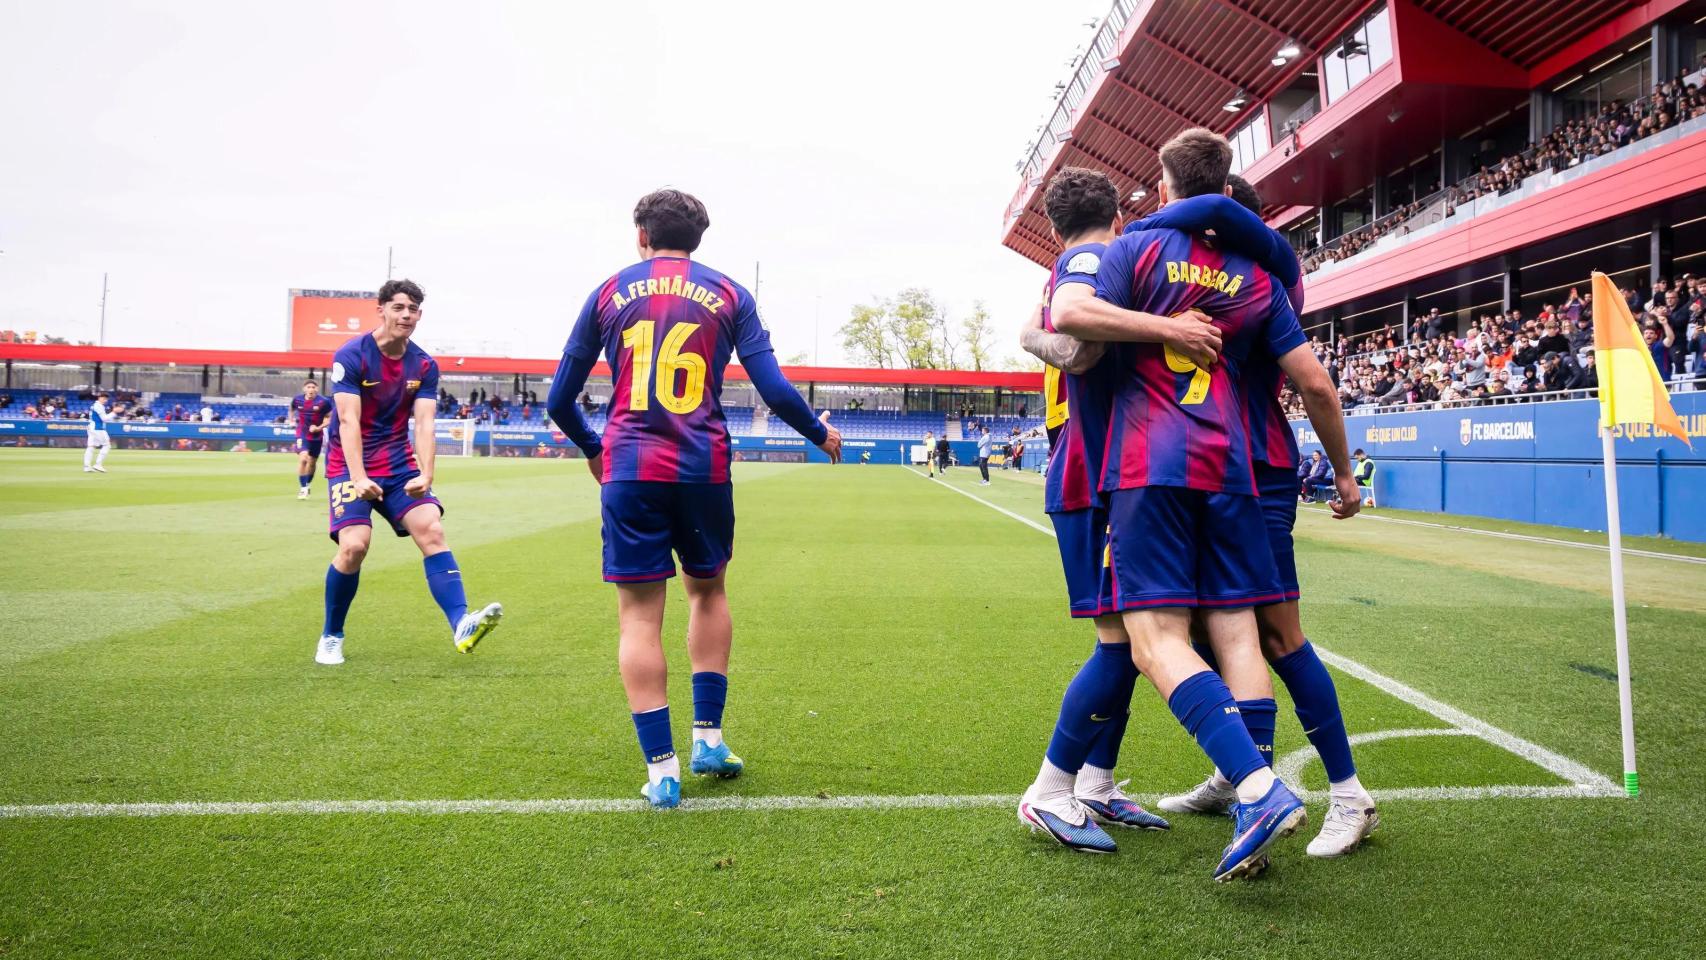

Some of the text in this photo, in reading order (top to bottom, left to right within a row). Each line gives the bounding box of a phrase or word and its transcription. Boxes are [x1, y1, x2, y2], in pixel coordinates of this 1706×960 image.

[302, 289, 330, 298] ESTADI
[333, 290, 360, 298] JOHAN
[1166, 261, 1244, 298] BARBERÁ
[611, 275, 726, 314] A.FERNÁNDEZ
[622, 320, 707, 415] 16
[1379, 427, 1391, 446] QUE
[1391, 427, 1401, 442] UN
[1401, 425, 1417, 441] CLUB
[1472, 421, 1534, 440] FC BARCELONA
[331, 480, 358, 508] 35
